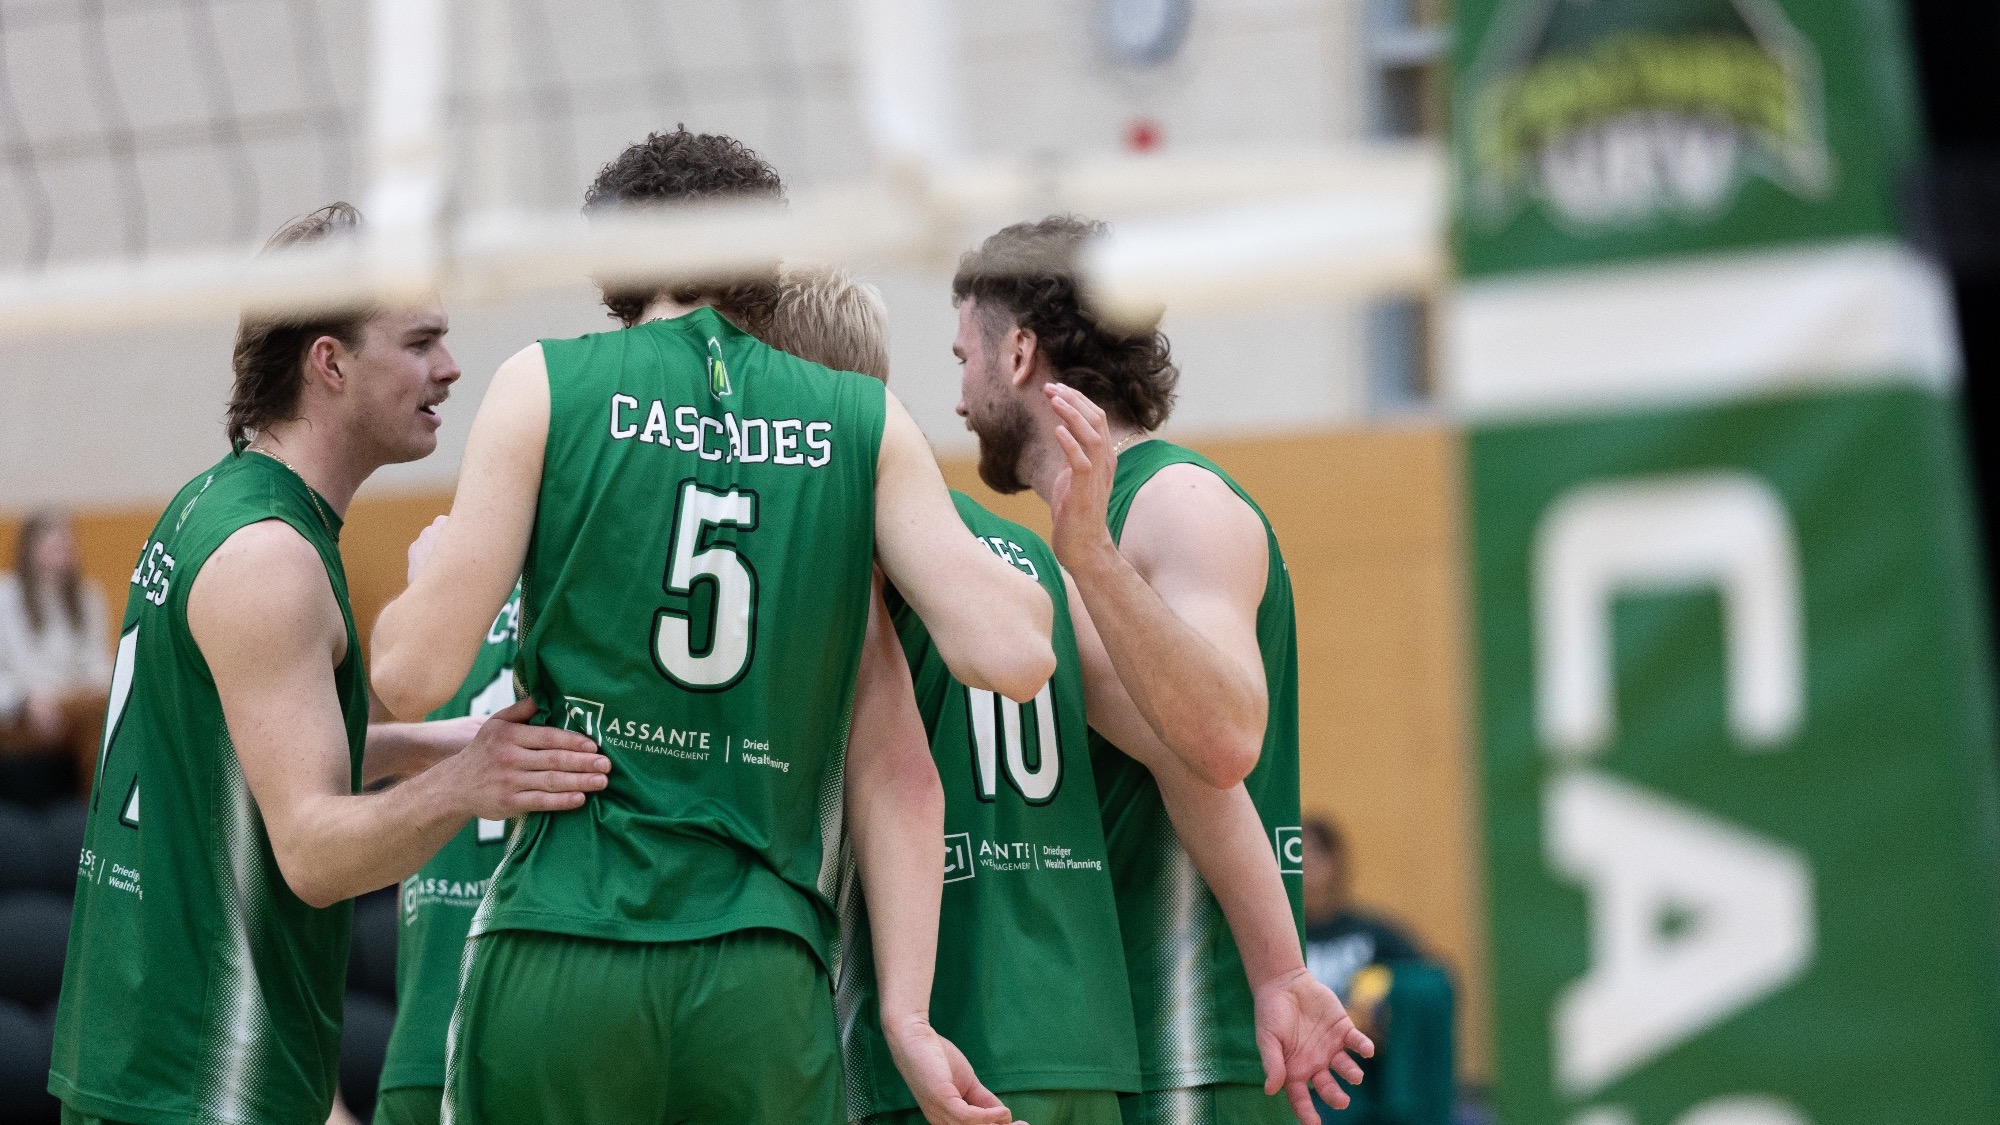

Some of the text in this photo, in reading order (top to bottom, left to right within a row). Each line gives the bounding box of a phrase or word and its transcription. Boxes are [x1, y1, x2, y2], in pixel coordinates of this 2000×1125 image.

[609, 392, 833, 468] CASCADES
[650, 476, 759, 694] 5
[605, 717, 712, 750] ASSANTE
[605, 735, 711, 762] WEALTH MANAGEMENT
[1531, 470, 1818, 1125] CA
[1066, 858, 1102, 871] Planning
[109, 875, 135, 893] Wealth
